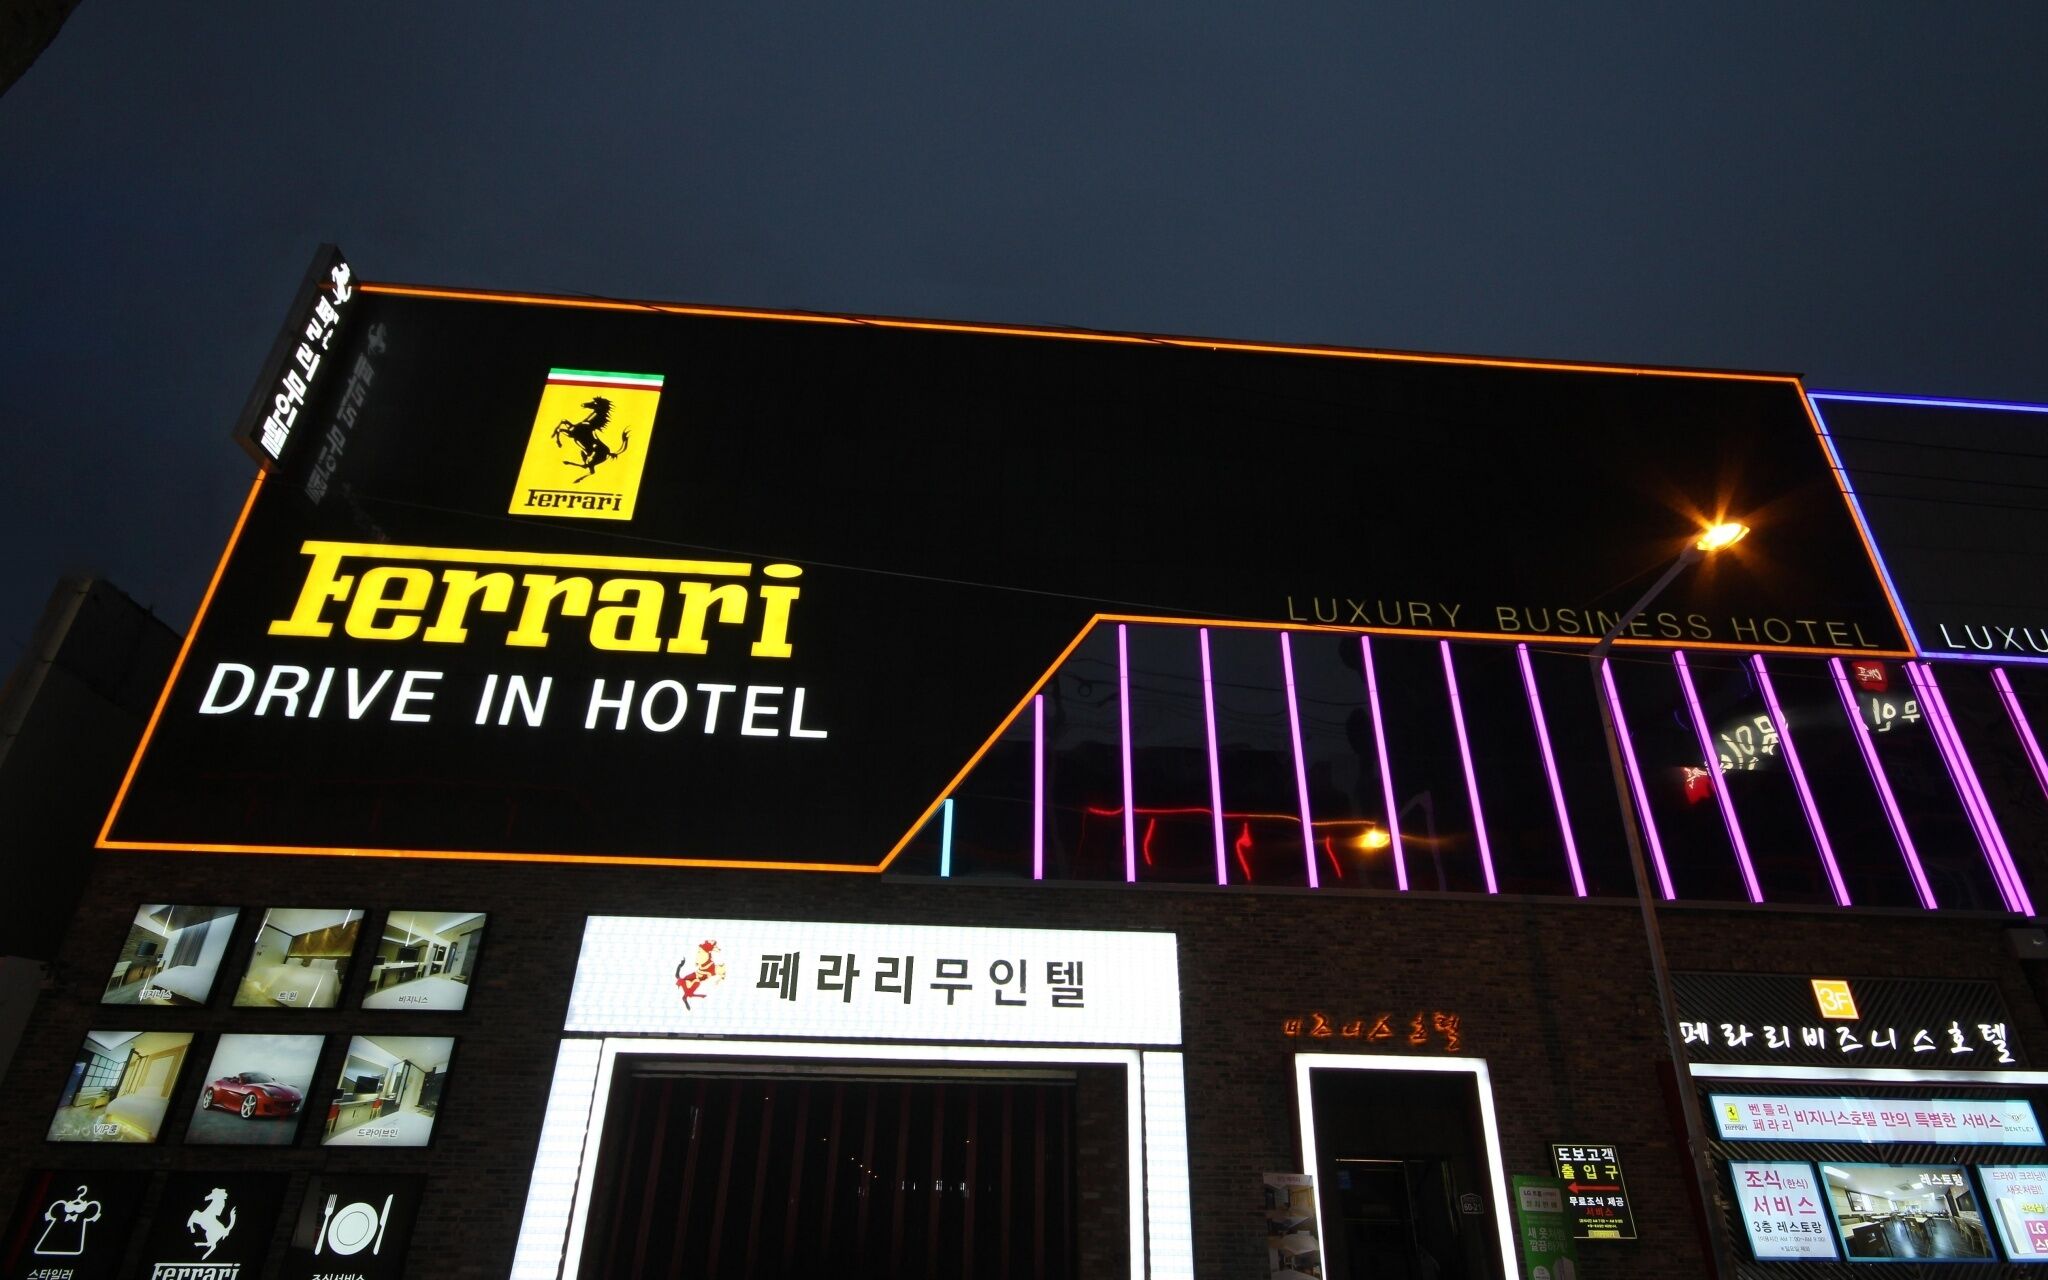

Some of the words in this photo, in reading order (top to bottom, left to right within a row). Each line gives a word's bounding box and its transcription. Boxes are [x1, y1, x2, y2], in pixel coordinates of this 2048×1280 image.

[524, 489, 623, 511] Ferrari
[267, 541, 803, 658] Ferrari
[1287, 596, 1460, 628] LUXURY
[1496, 606, 1712, 638] BUSINESS
[1732, 617, 1878, 648] HOTEL
[1940, 623, 2048, 653] LUXU
[199, 663, 443, 722] DRIVE
[475, 674, 552, 726] IN
[585, 679, 827, 738] HOTEL
[756, 951, 1085, 1008] 페라리무인텔
[398, 995, 428, 1004] 비지니스
[1819, 987, 1850, 1011] 3F
[1679, 1021, 2016, 1063] 페라리비즈니스호텔
[1753, 1118, 1794, 1132] 페라리
[1794, 1109, 1878, 1127] 비지니스호텔
[1880, 1111, 1911, 1128] 만의
[1914, 1112, 1957, 1129] 특별한
[1962, 1113, 2002, 1129] 서비스
[357, 1128, 398, 1138] 드라이브인
[1557, 1147, 1615, 1163] 도보고객
[1919, 1173, 1964, 1187] 레스토랑
[1754, 1195, 1817, 1216] 서비스
[1753, 1221, 1772, 1233] 3층
[1776, 1221, 1823, 1234] 레스토랑
[2028, 1222, 2047, 1235] LG
[27, 1268, 74, 1280] 스타일러
[151, 1262, 241, 1280] Ferrari
